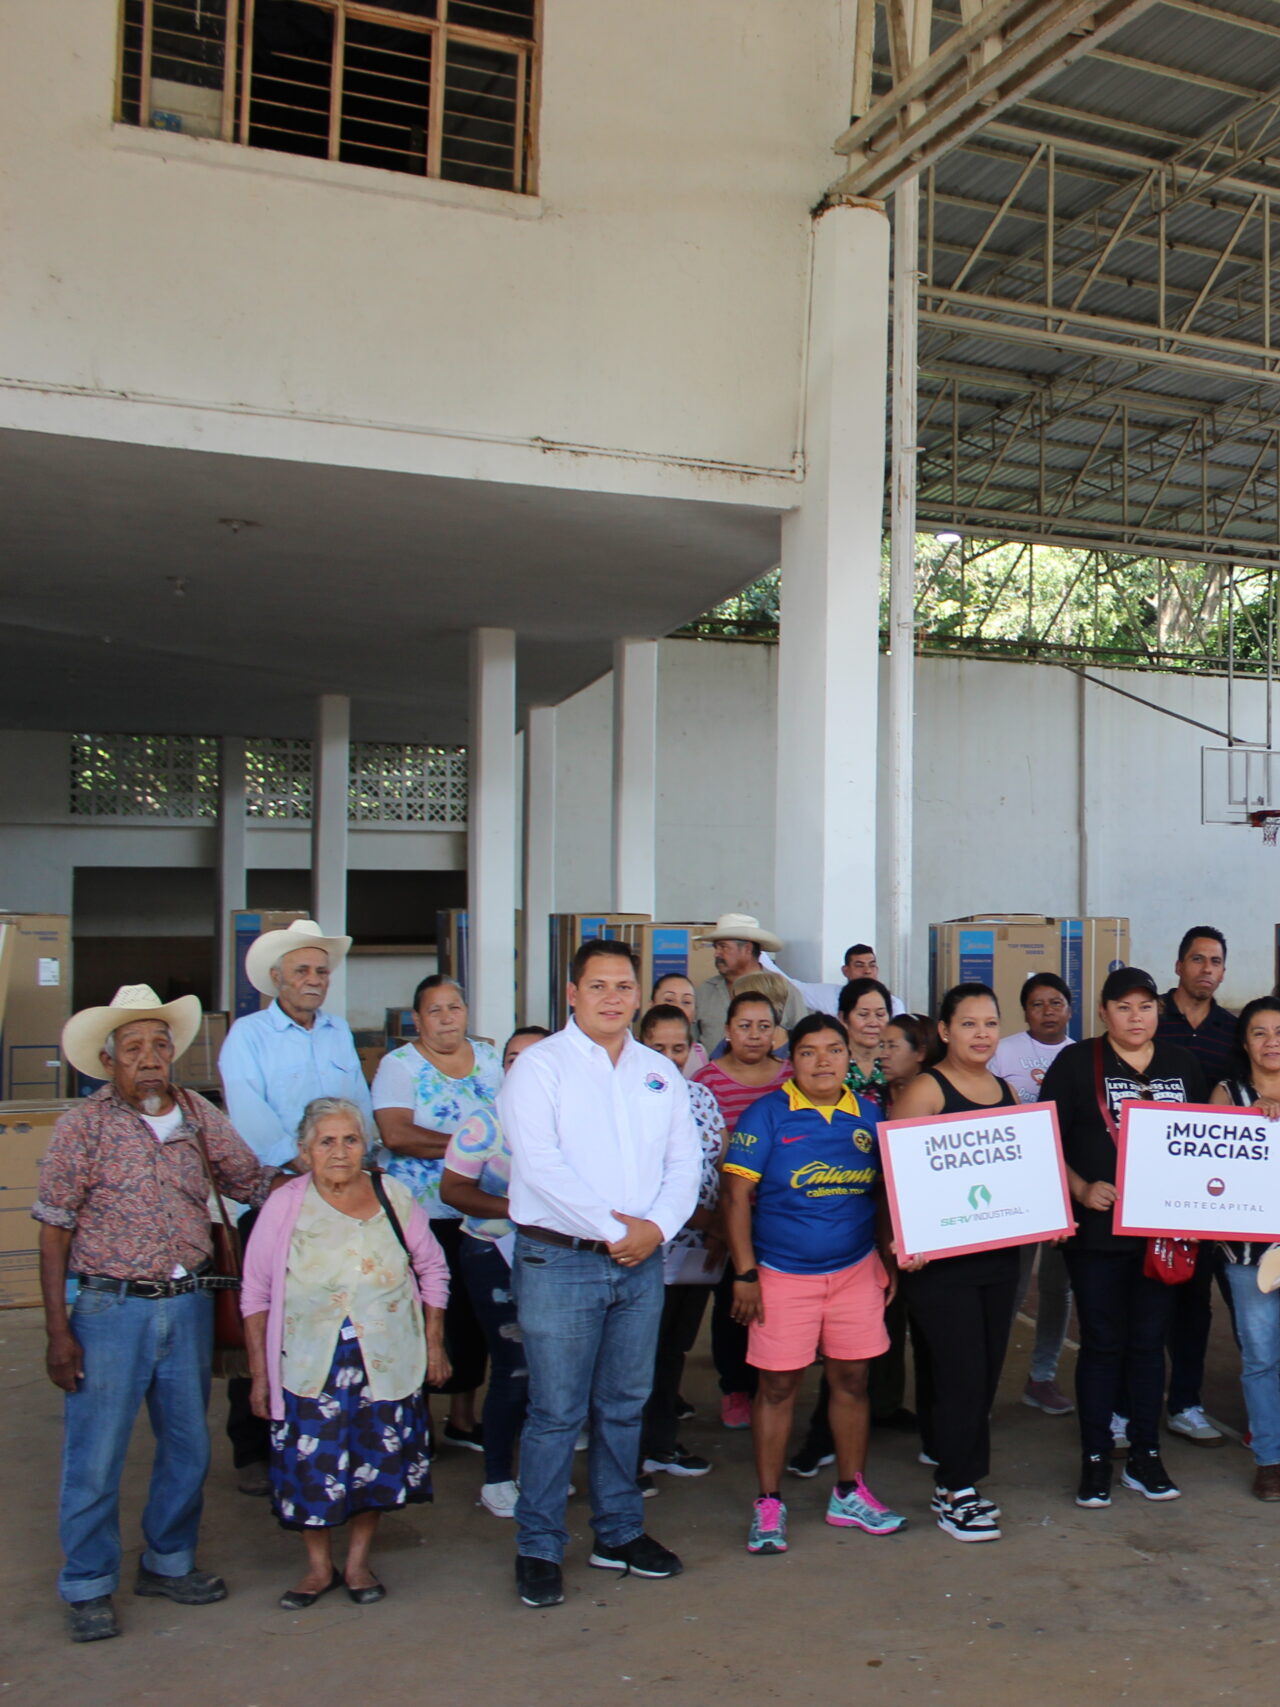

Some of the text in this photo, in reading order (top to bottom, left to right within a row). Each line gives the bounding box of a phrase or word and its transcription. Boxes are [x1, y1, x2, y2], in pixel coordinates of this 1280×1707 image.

[1108, 1082, 1129, 1090] LEVI
[925, 1126, 1016, 1156] ¡MUCHAS
[1166, 1122, 1267, 1142] ¡MUCHAS
[930, 1144, 1023, 1171] GRACIAS!
[1168, 1140, 1269, 1161] GRACIAS!
[1164, 1200, 1265, 1212] NORTECAPITAL
